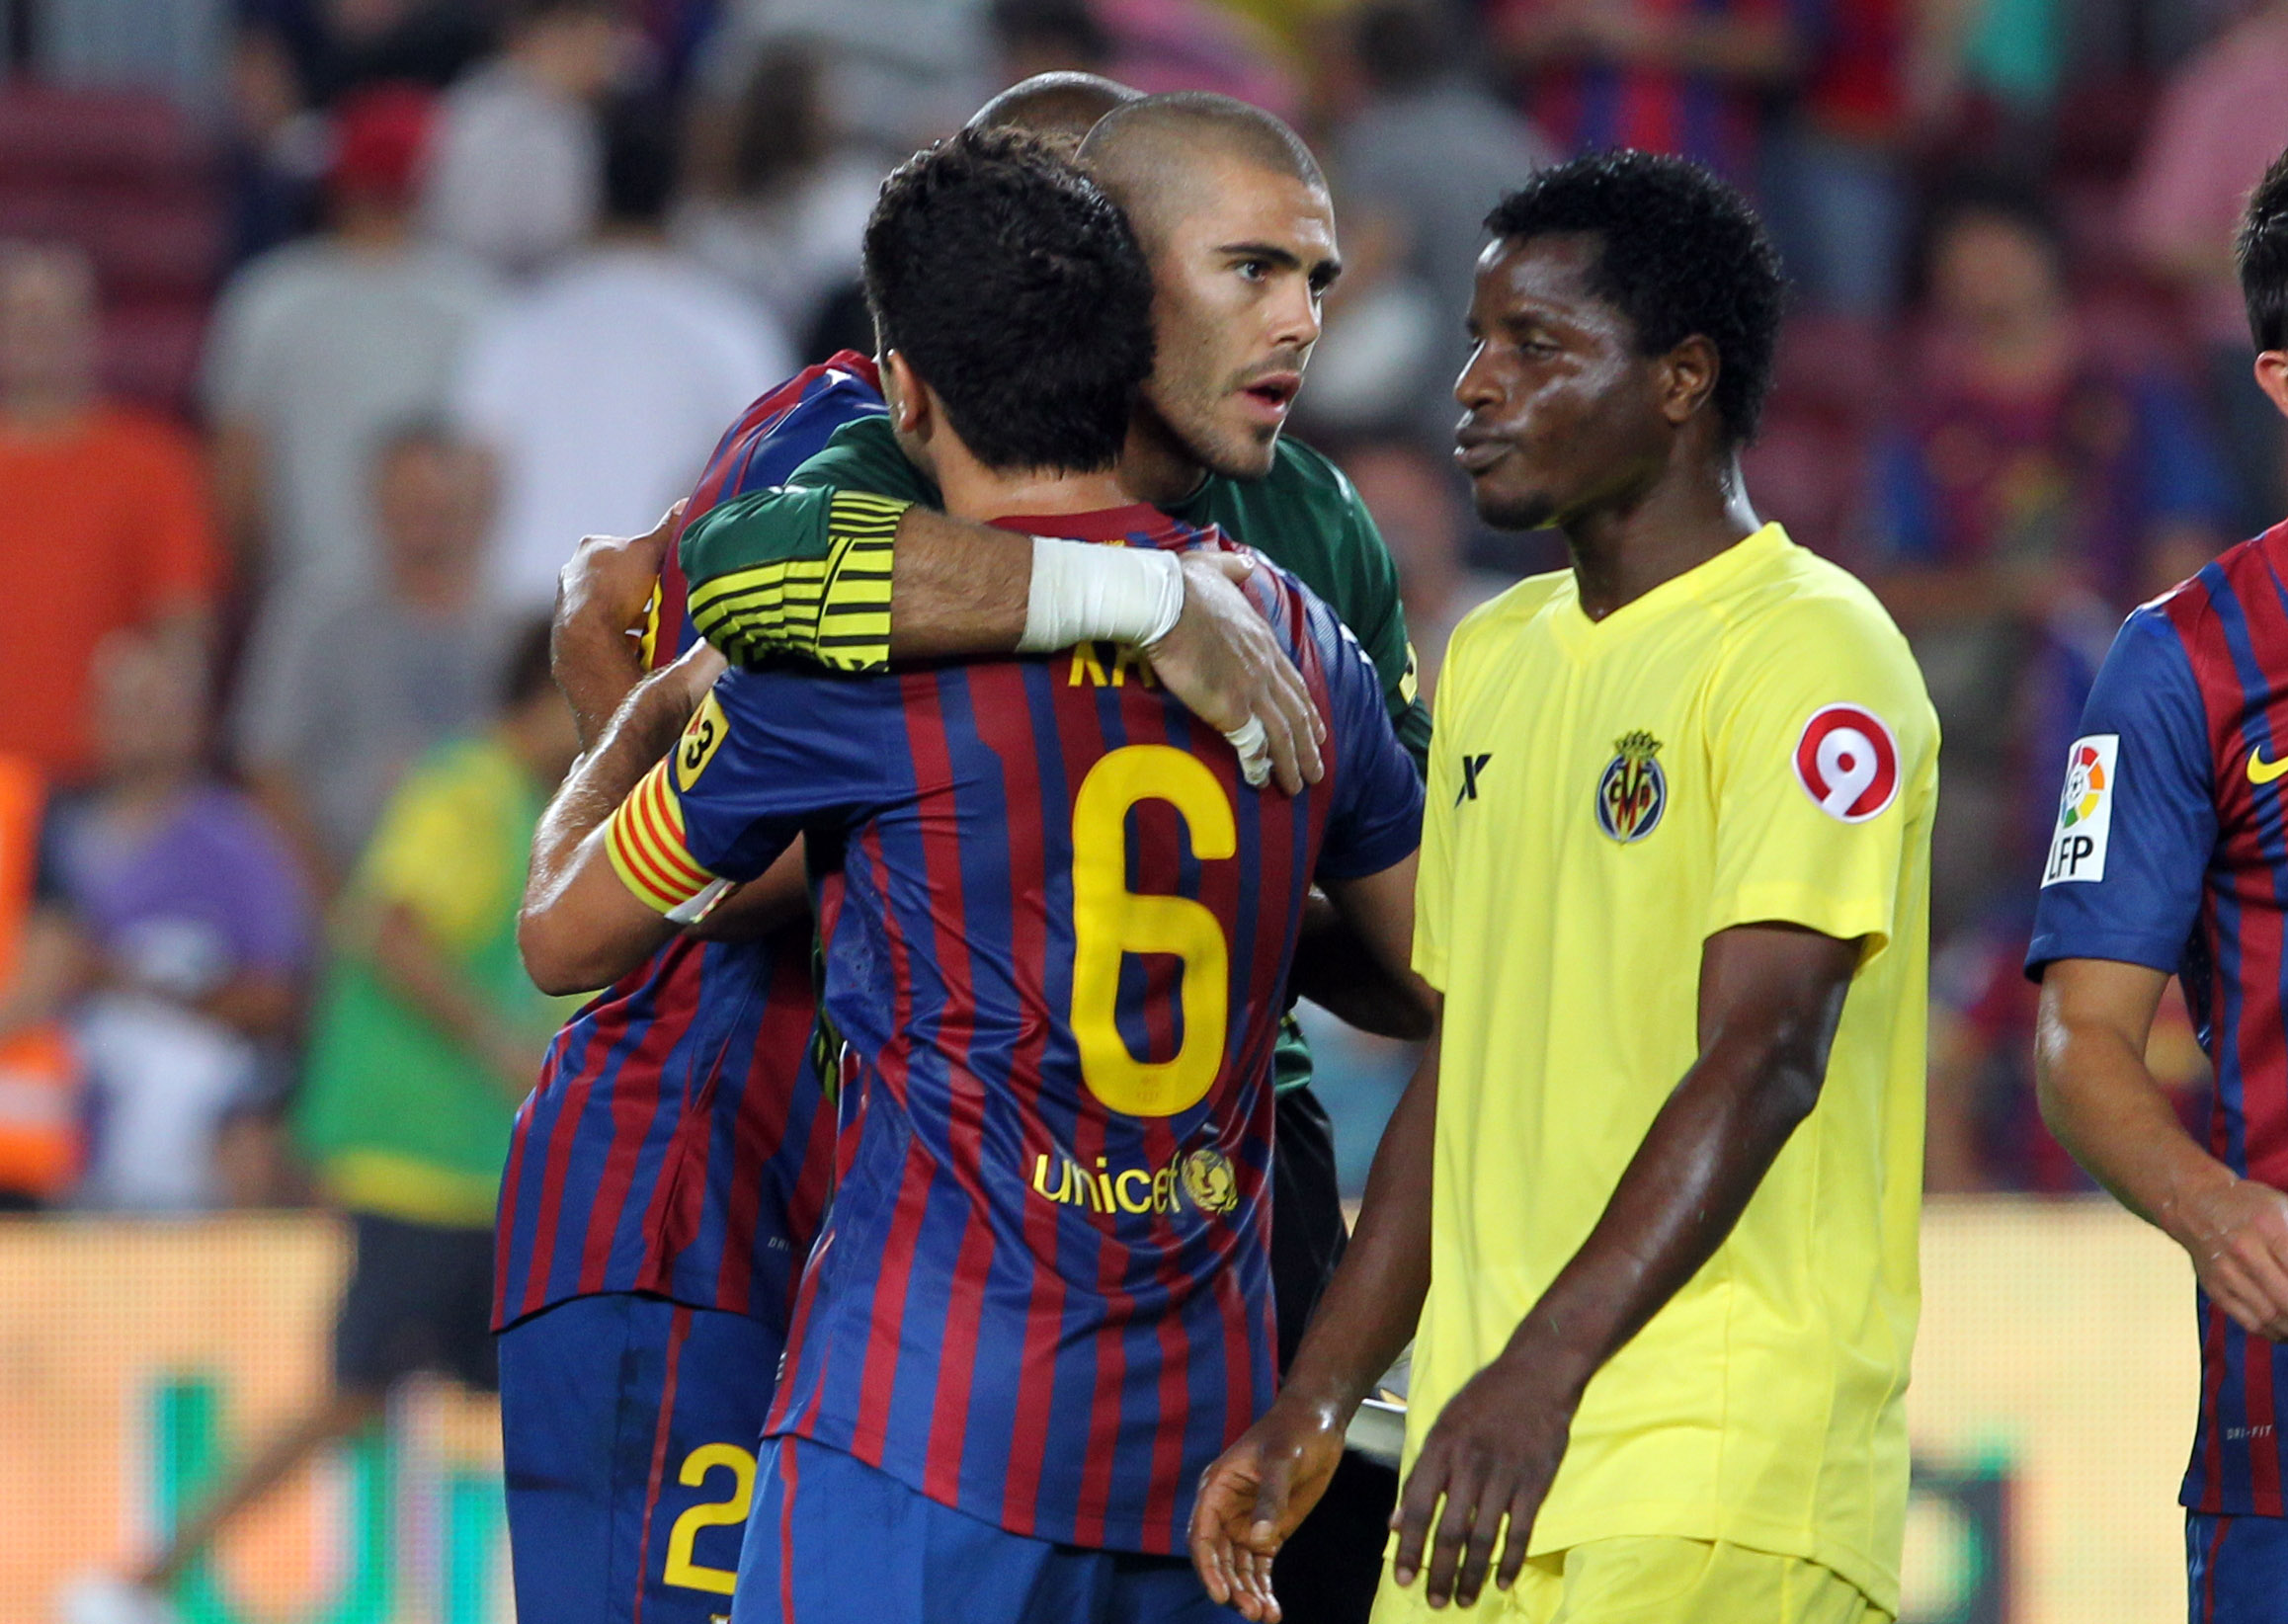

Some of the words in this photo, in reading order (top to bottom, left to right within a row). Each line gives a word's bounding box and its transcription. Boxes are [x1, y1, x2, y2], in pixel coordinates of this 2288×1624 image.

[686, 719, 714, 770] 3
[2047, 835, 2094, 881] LFP
[1070, 744, 1237, 1117] 6
[1032, 1149, 1182, 1215] unicef
[663, 1441, 759, 1596] 2
